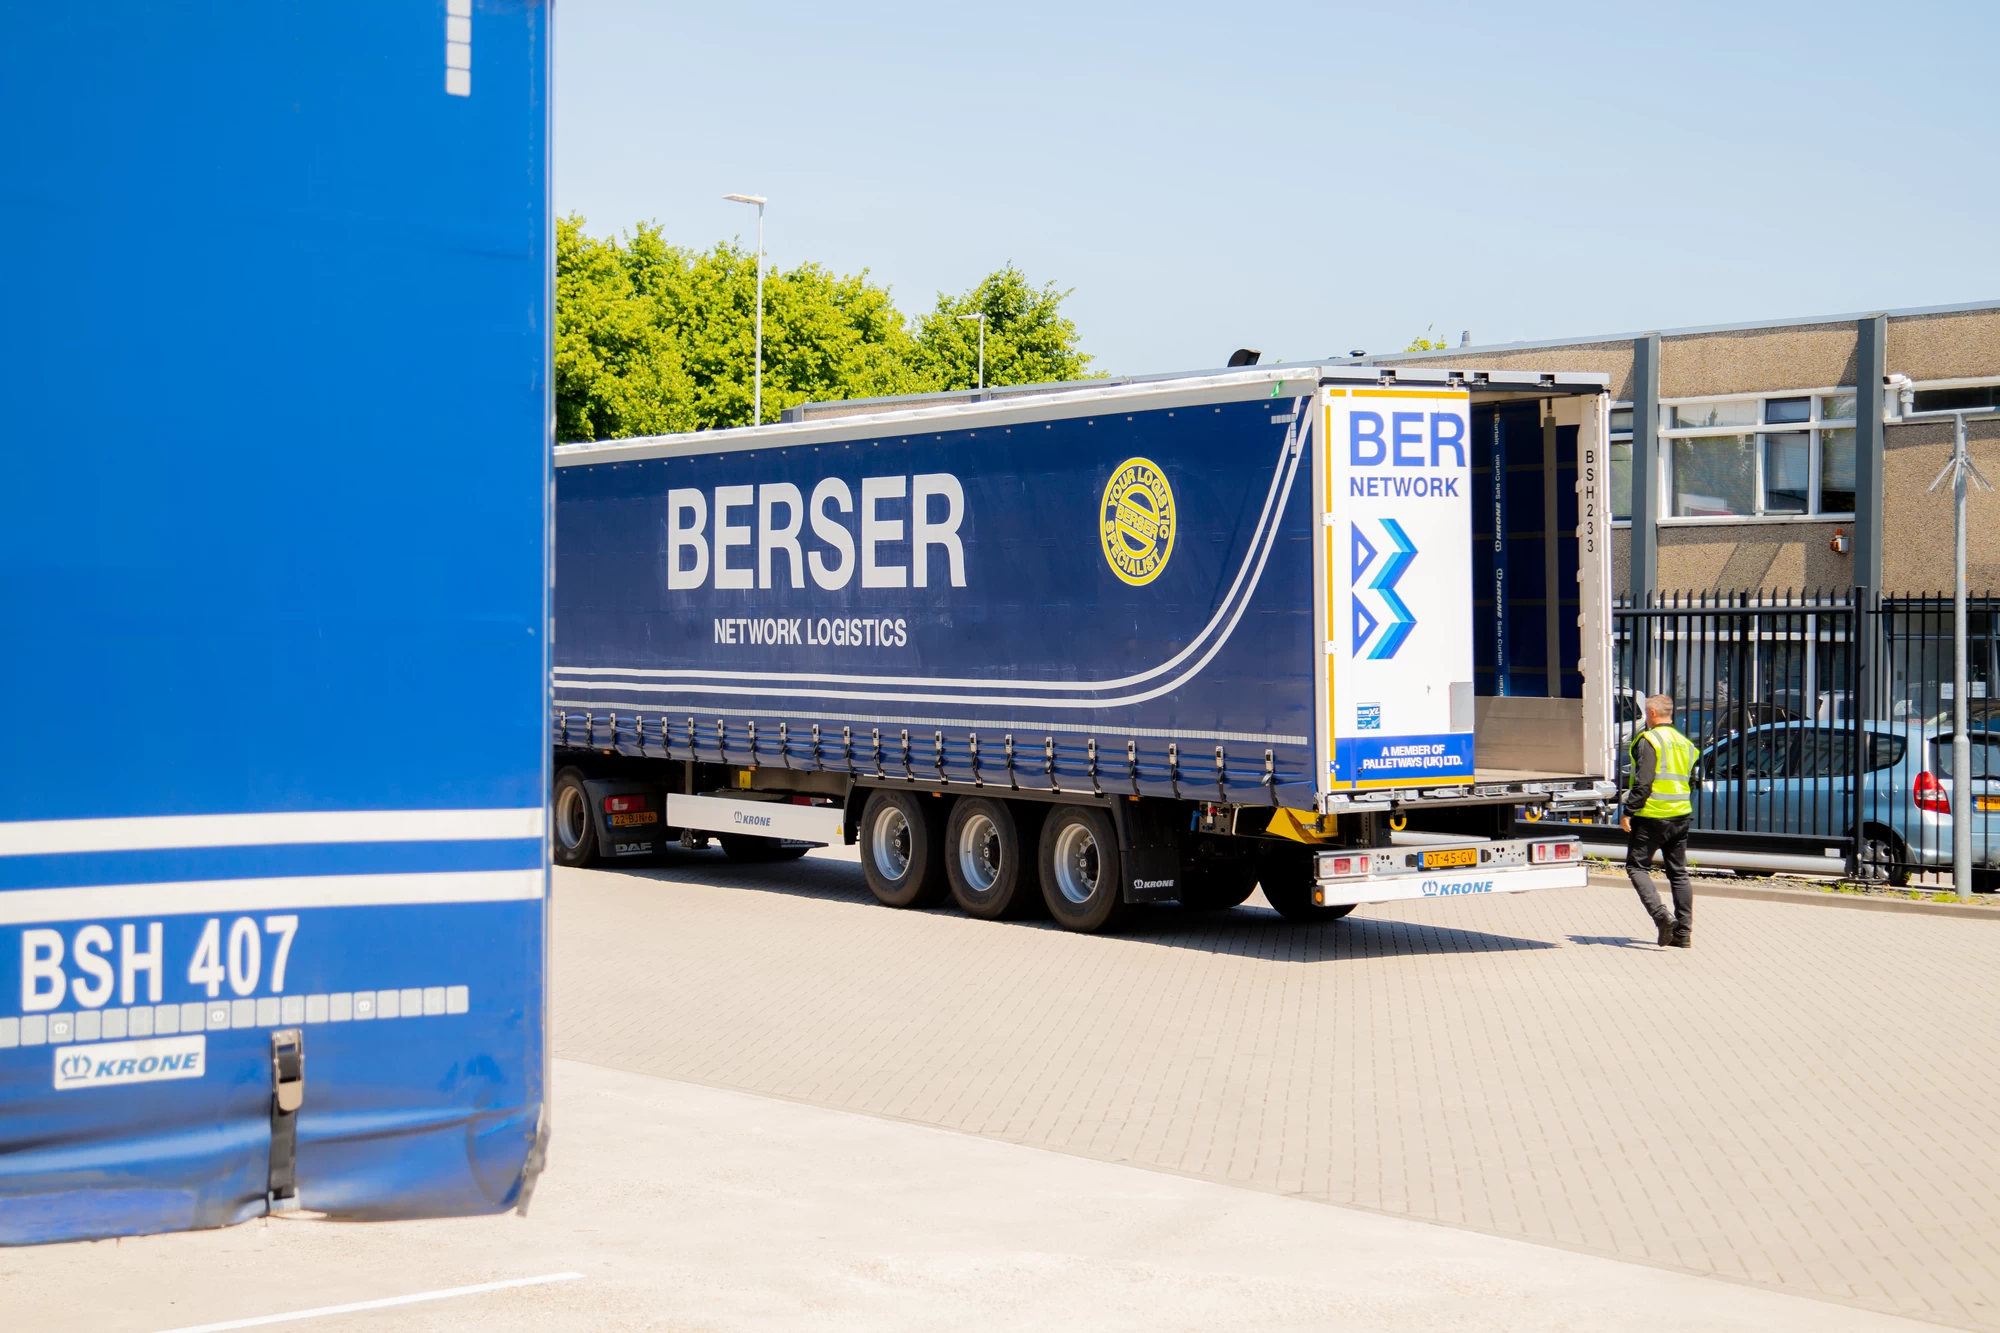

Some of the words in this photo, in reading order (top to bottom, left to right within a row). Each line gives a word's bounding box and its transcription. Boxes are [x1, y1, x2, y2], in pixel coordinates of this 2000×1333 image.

[1350, 411, 1466, 468] BER
[1350, 477, 1460, 498] NETWORK
[1108, 468, 1136, 507] YOUR
[1137, 467, 1170, 539] LOGISTIC
[667, 473, 968, 591] BERSER
[1116, 503, 1159, 540] BERSER
[1105, 520, 1160, 576] SPECIALIST
[714, 618, 802, 645] NETWORK
[808, 618, 907, 647] LOGISTICS
[1381, 747, 1389, 757] A
[1390, 745, 1431, 756] MEMBER
[1432, 744, 1445, 754] OF
[1363, 757, 1422, 769] PALLETWAYS
[1423, 756, 1443, 768] (UK)
[1444, 755, 1463, 766] LTD.
[614, 813, 654, 825] 22-BJN-6
[743, 815, 771, 826] KRONE
[615, 842, 652, 852] DAF
[1427, 852, 1473, 866] OT-45-GV
[1143, 879, 1174, 888] KRONE
[1440, 881, 1493, 896] KRONE
[21, 921, 163, 1011] BSH
[188, 914, 299, 997] 407
[94, 1052, 200, 1078] KRONE
